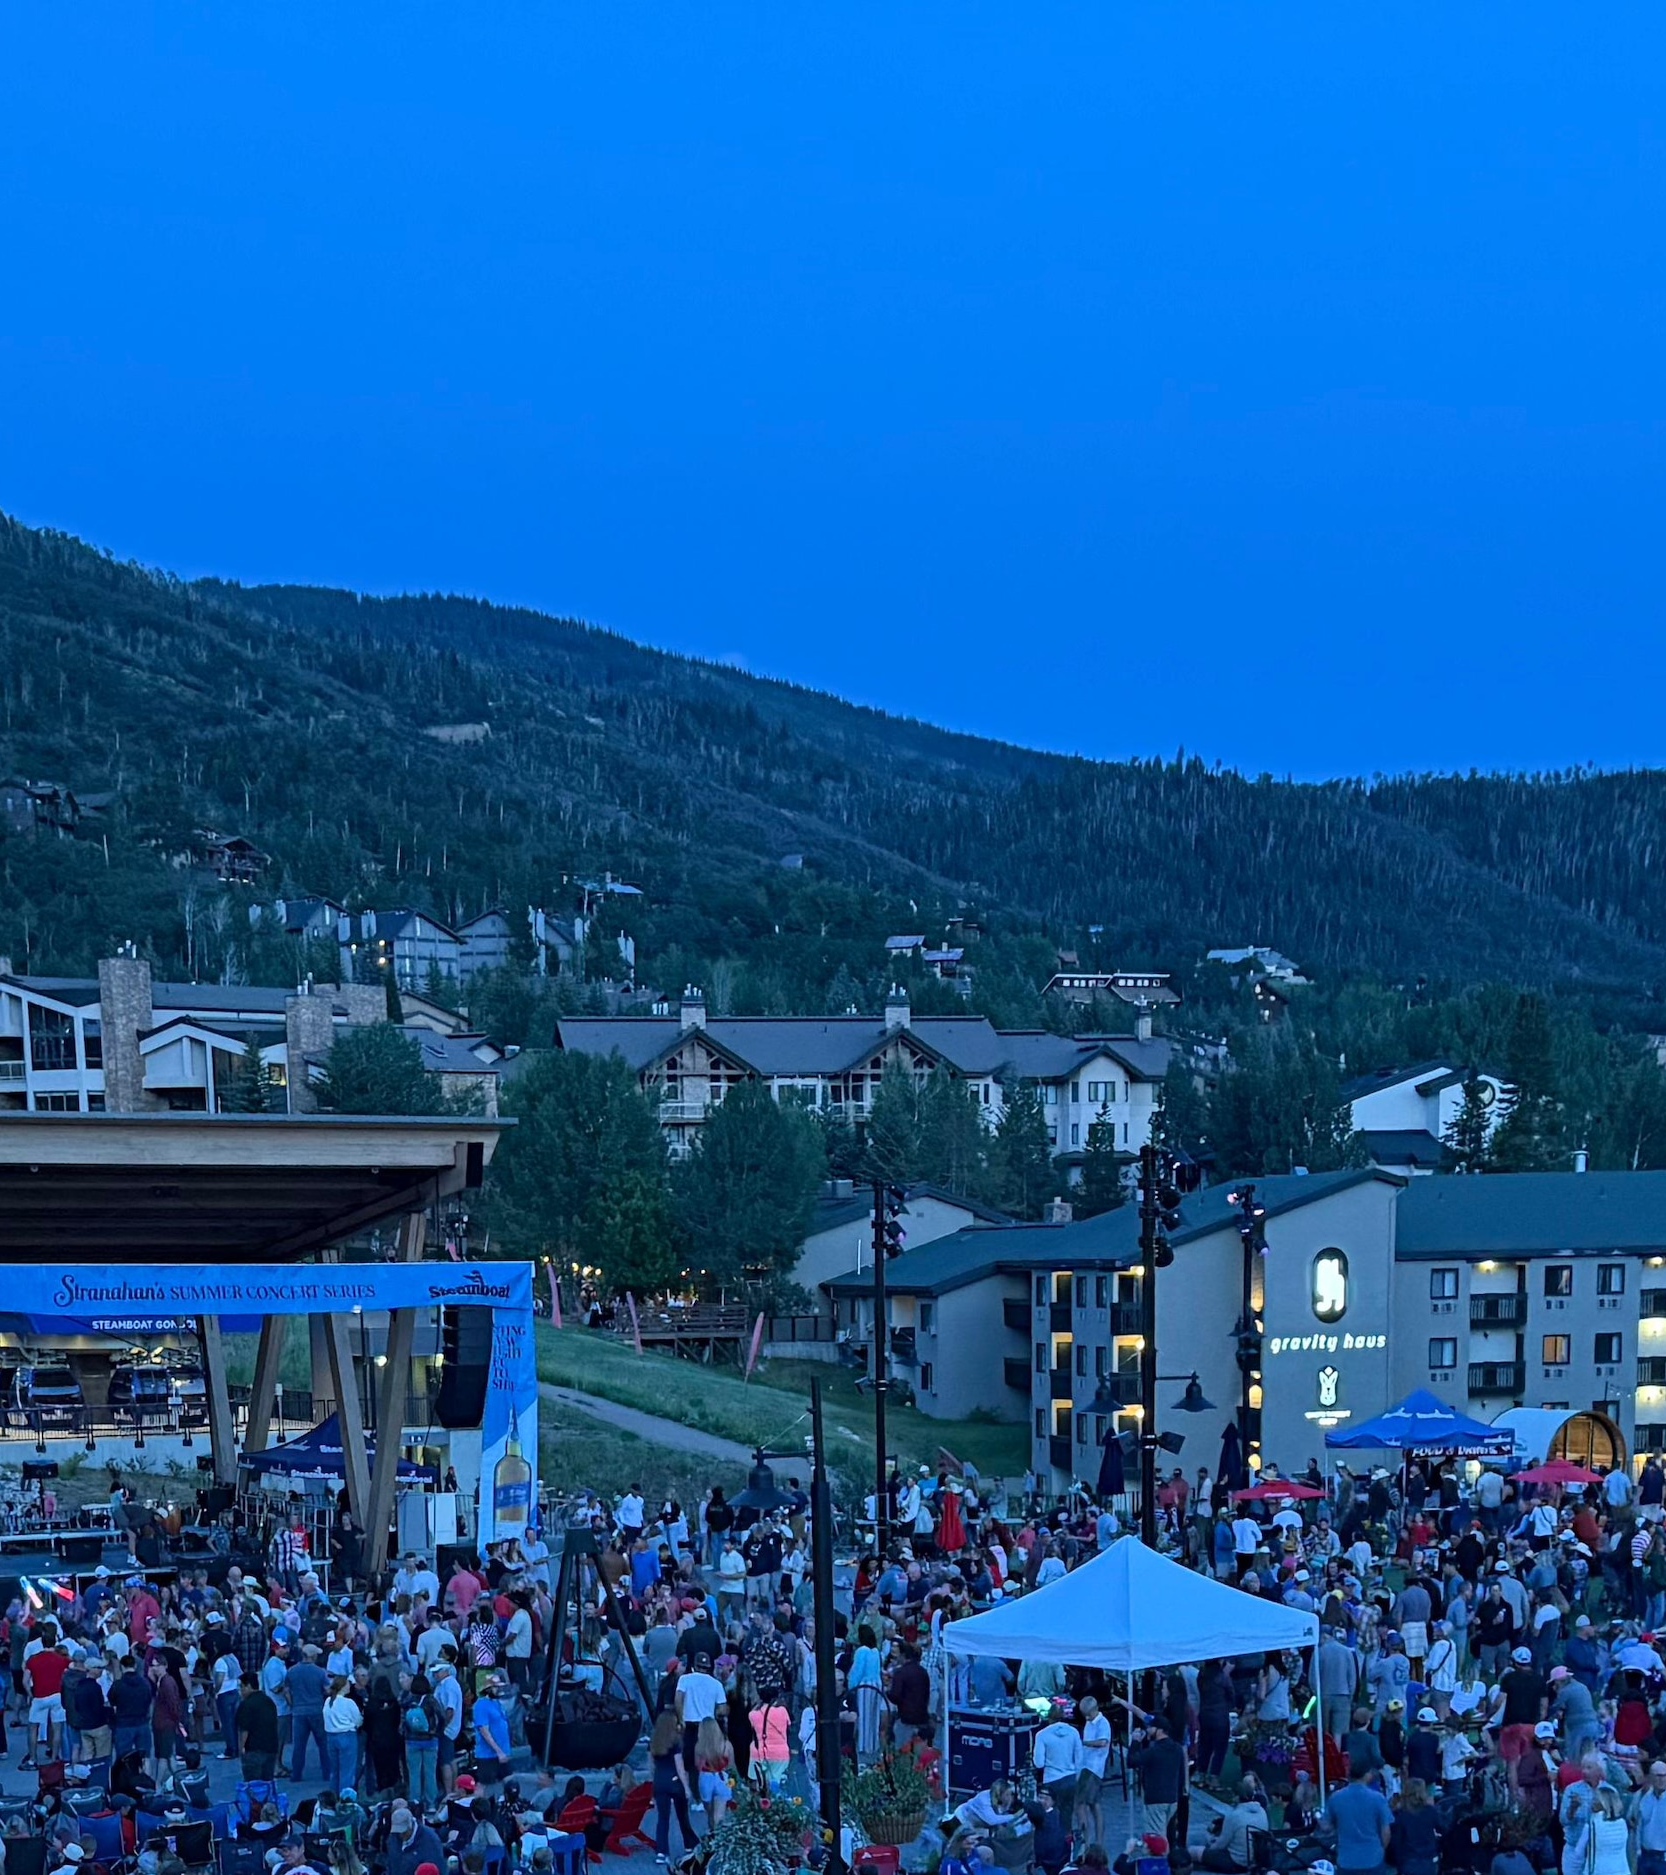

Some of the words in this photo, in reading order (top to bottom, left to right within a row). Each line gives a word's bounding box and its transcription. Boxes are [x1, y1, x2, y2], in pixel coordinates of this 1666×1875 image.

[53, 1274, 165, 1308] Stranahan's
[170, 1285, 243, 1300] SUMMER
[246, 1284, 320, 1300] CONCERT
[323, 1283, 376, 1298] SERIES
[428, 1273, 510, 1299] Steamboat
[92, 1319, 153, 1330] STEAMBOAT
[1270, 1333, 1338, 1354] gravity
[1343, 1332, 1386, 1349] haus
